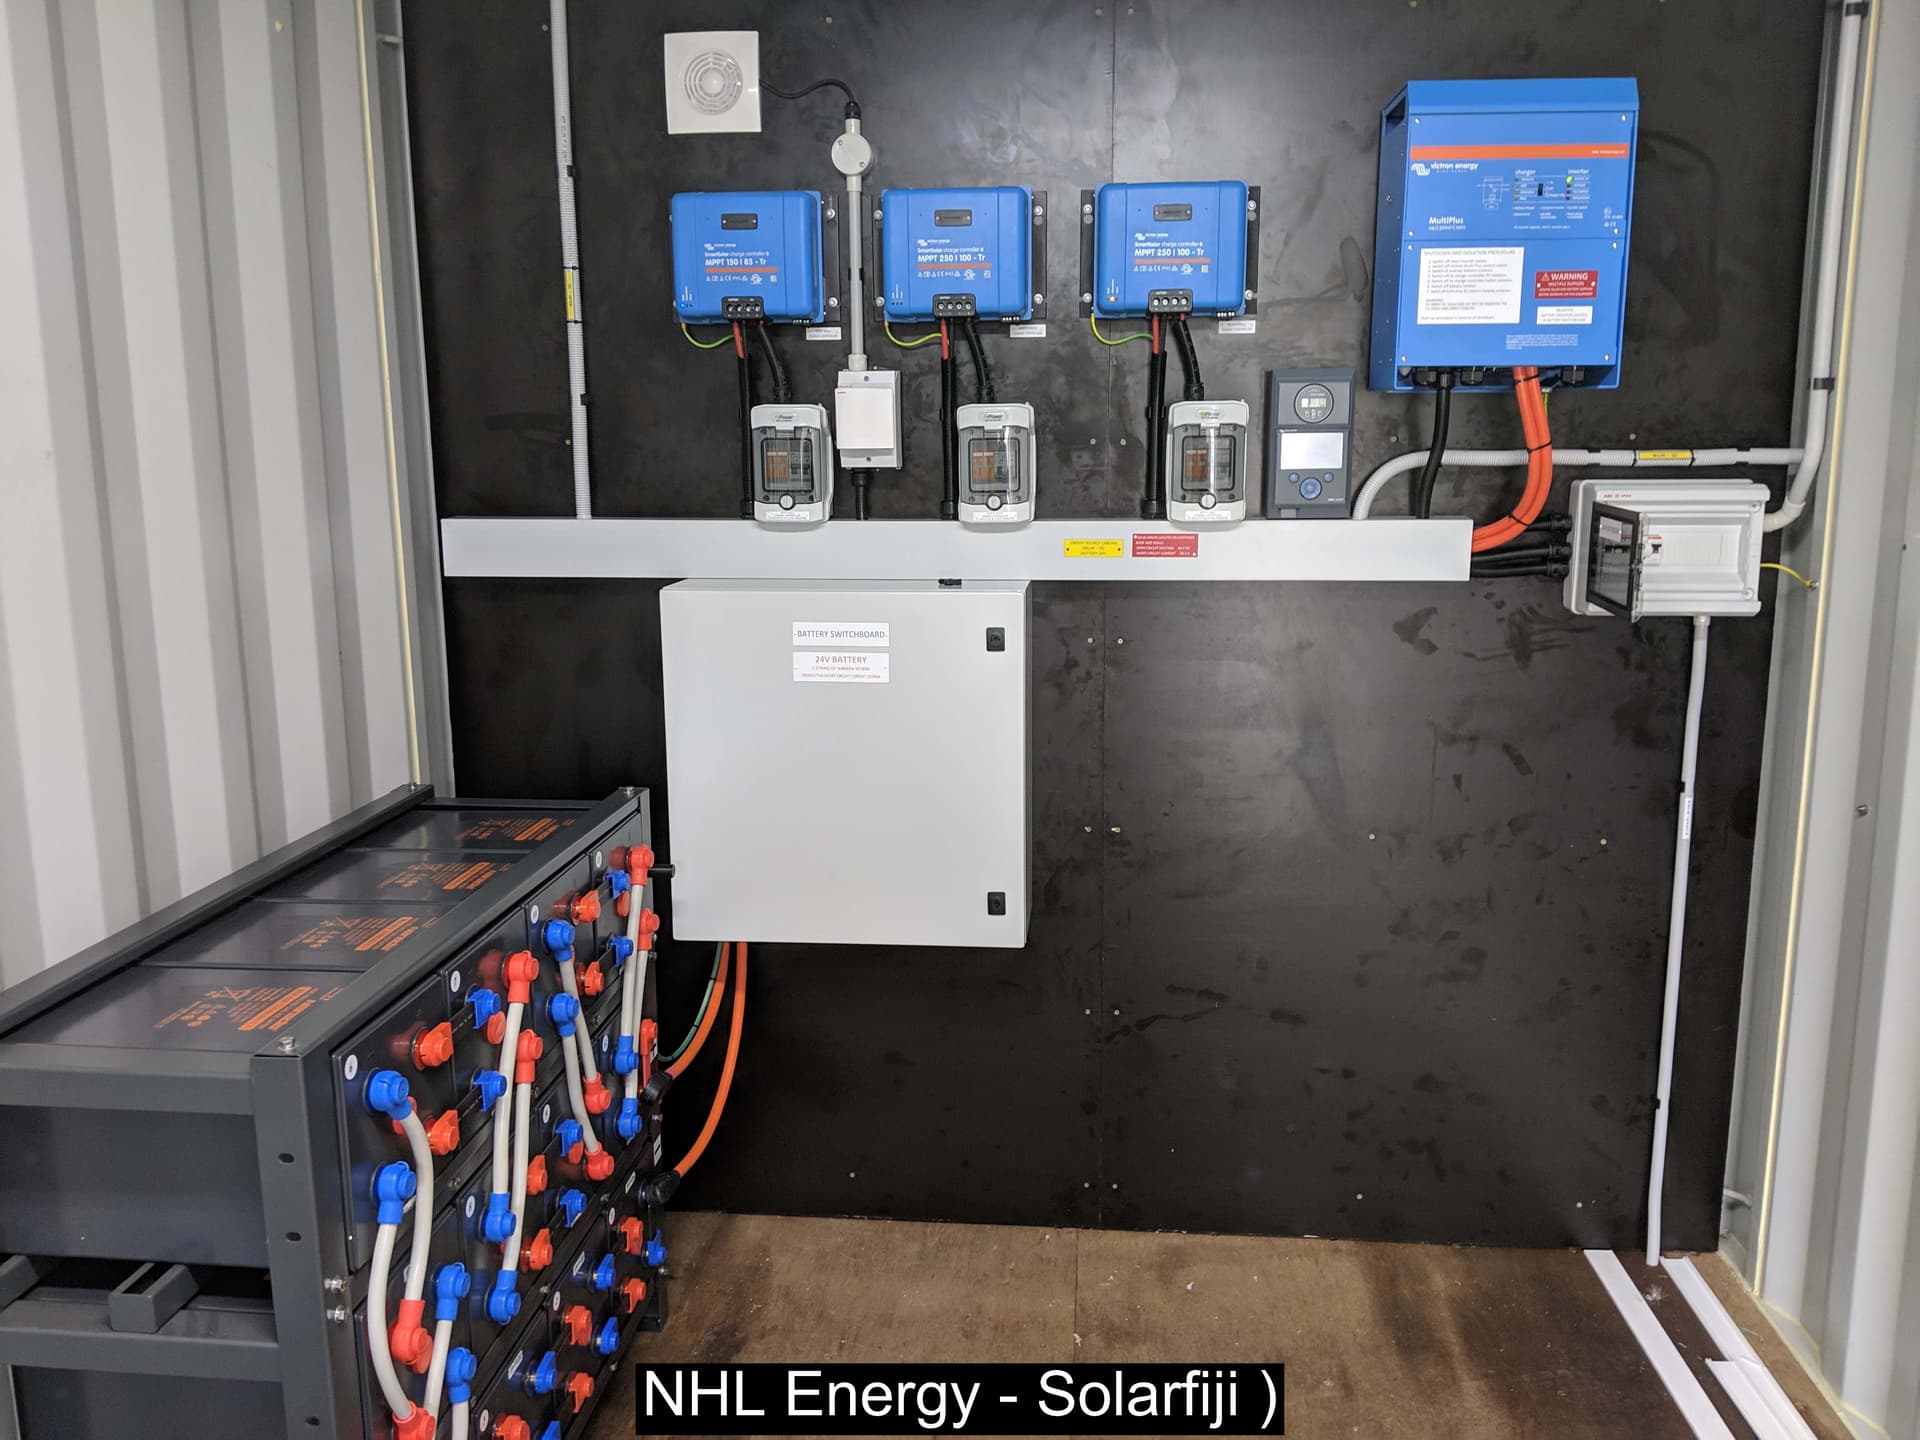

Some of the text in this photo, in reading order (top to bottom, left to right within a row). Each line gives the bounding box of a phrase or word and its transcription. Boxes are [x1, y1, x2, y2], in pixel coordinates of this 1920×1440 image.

[1429, 216, 1464, 225] MultiPlus
[1551, 272, 1588, 281] WARNING
[830, 630, 885, 638] SWITCHBOARD
